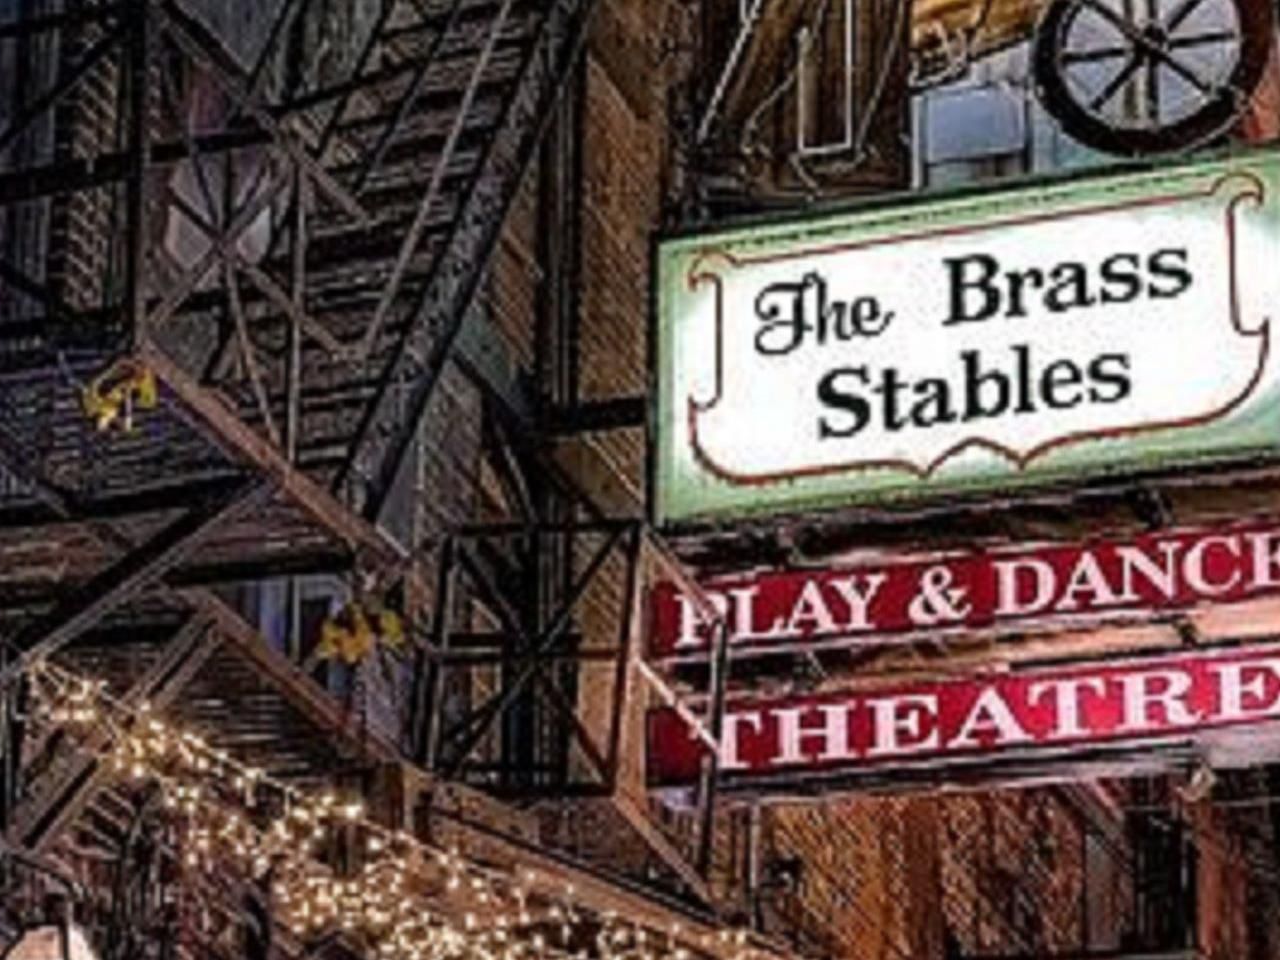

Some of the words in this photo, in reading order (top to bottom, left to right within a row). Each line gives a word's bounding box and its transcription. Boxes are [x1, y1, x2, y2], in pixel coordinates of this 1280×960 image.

[753, 272, 895, 356] The
[941, 246, 1194, 328] Brass
[818, 345, 1133, 441] Stables
[673, 572, 887, 649] PLAY
[907, 565, 973, 627] &
